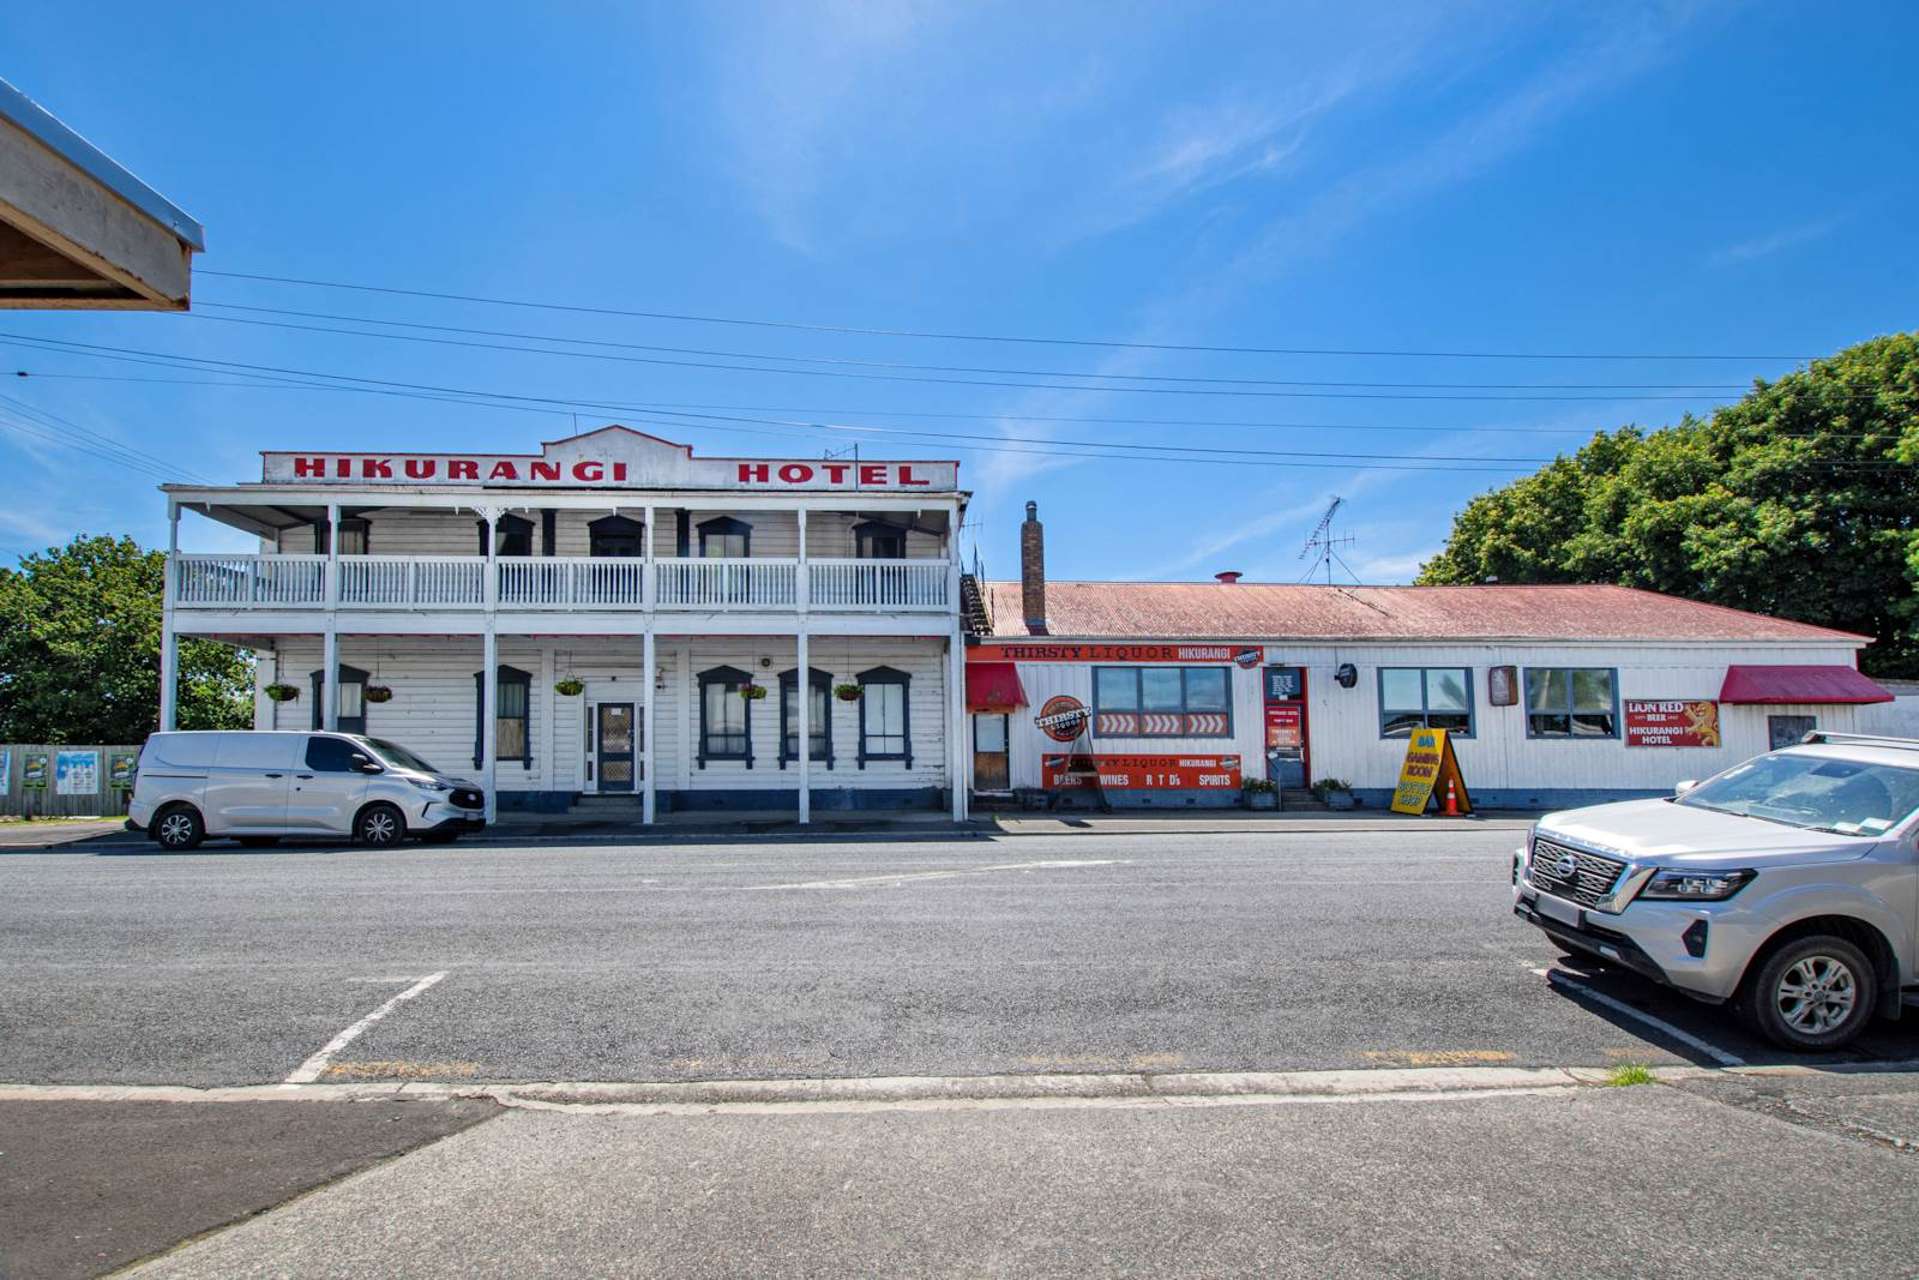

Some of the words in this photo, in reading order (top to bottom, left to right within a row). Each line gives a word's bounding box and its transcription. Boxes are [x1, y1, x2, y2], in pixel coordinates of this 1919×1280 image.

[294, 457, 627, 482] HIKURANGI
[738, 463, 930, 485] HOTEL
[1001, 646, 1081, 659] THIRSTY
[1088, 646, 1173, 661] LIQUOR
[1178, 647, 1231, 660] HIKURANGI
[1629, 702, 1657, 713] LION
[1660, 702, 1684, 713] RED
[1034, 706, 1091, 729] THIRSTY
[1629, 726, 1684, 735] HIKURANGI
[1642, 736, 1673, 745] HOTEL
[1120, 759, 1176, 769] LIQUOR
[1053, 774, 1082, 785] BEERS
[1099, 774, 1129, 786] WINES
[1146, 774, 1153, 786] R
[1158, 774, 1165, 786] T
[1199, 774, 1231, 786] SPIRITS
